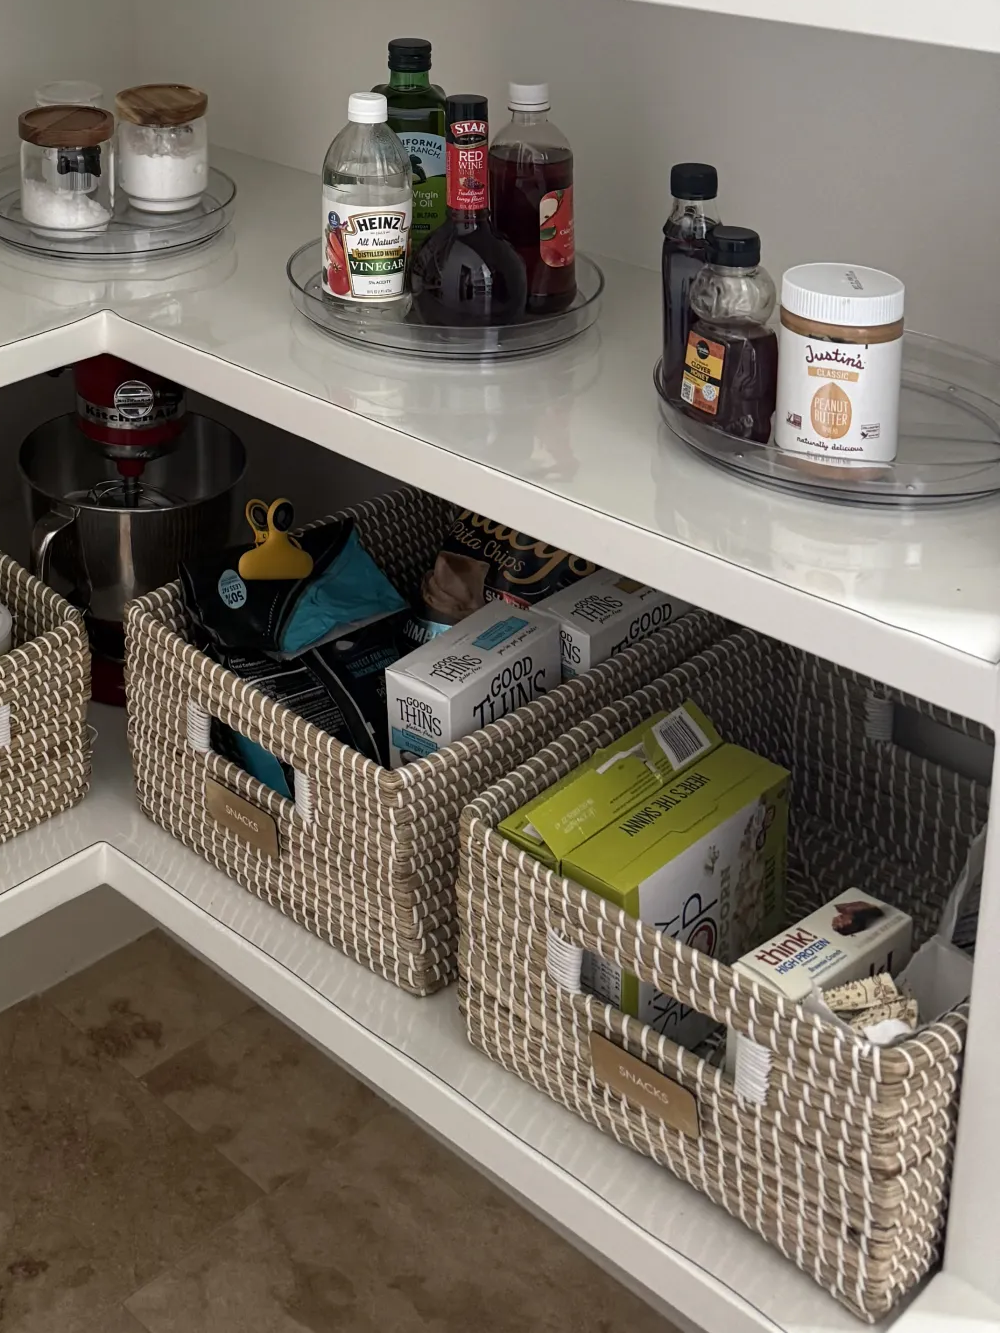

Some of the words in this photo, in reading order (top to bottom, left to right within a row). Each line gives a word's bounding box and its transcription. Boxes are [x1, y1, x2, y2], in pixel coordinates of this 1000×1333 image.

[454, 123, 486, 135] STAR
[459, 150, 484, 162] RED
[458, 160, 484, 170] WINE
[457, 188, 485, 197] Traditional
[419, 200, 433, 208] Oil
[355, 217, 401, 232] HEINZ
[357, 237, 370, 247] All
[371, 237, 400, 247] Natural
[357, 249, 385, 259] DISTILLED
[385, 248, 401, 258] WHITE
[350, 258, 405, 273] VINEGAR
[805, 344, 865, 370] Justin's
[690, 360, 711, 375] CLOVER
[690, 368, 710, 382] HONEY
[816, 368, 849, 380] CLASSIC
[85, 403, 179, 423] KitchnAid
[814, 397, 849, 413] PEANUT
[814, 409, 848, 427] BUTTER
[796, 436, 829, 451] naturally
[831, 443, 864, 452] delicious
[451, 519, 482, 551] Pita
[483, 536, 526, 573] Chips
[221, 586, 231, 594] FAT
[230, 583, 242, 592] LESS
[225, 591, 245, 605] 50%
[574, 594, 600, 609] GOOD
[570, 596, 624, 623] THINS
[629, 603, 673, 640] GOOD
[429, 654, 483, 683] THINS
[432, 655, 459, 670] GOOD
[490, 656, 533, 698] GOOD
[406, 696, 434, 715] GOOD
[396, 697, 443, 737] THINS
[669, 772, 711, 800] HERE'S
[652, 791, 681, 814] THE
[225, 804, 259, 833] SNACKS
[618, 806, 662, 838] SKINNY
[754, 927, 820, 966] think!
[775, 956, 798, 975] HIGH
[797, 938, 831, 963] PROTEIN
[807, 958, 828, 973] Brownie
[619, 1065, 669, 1104] SNACKS
